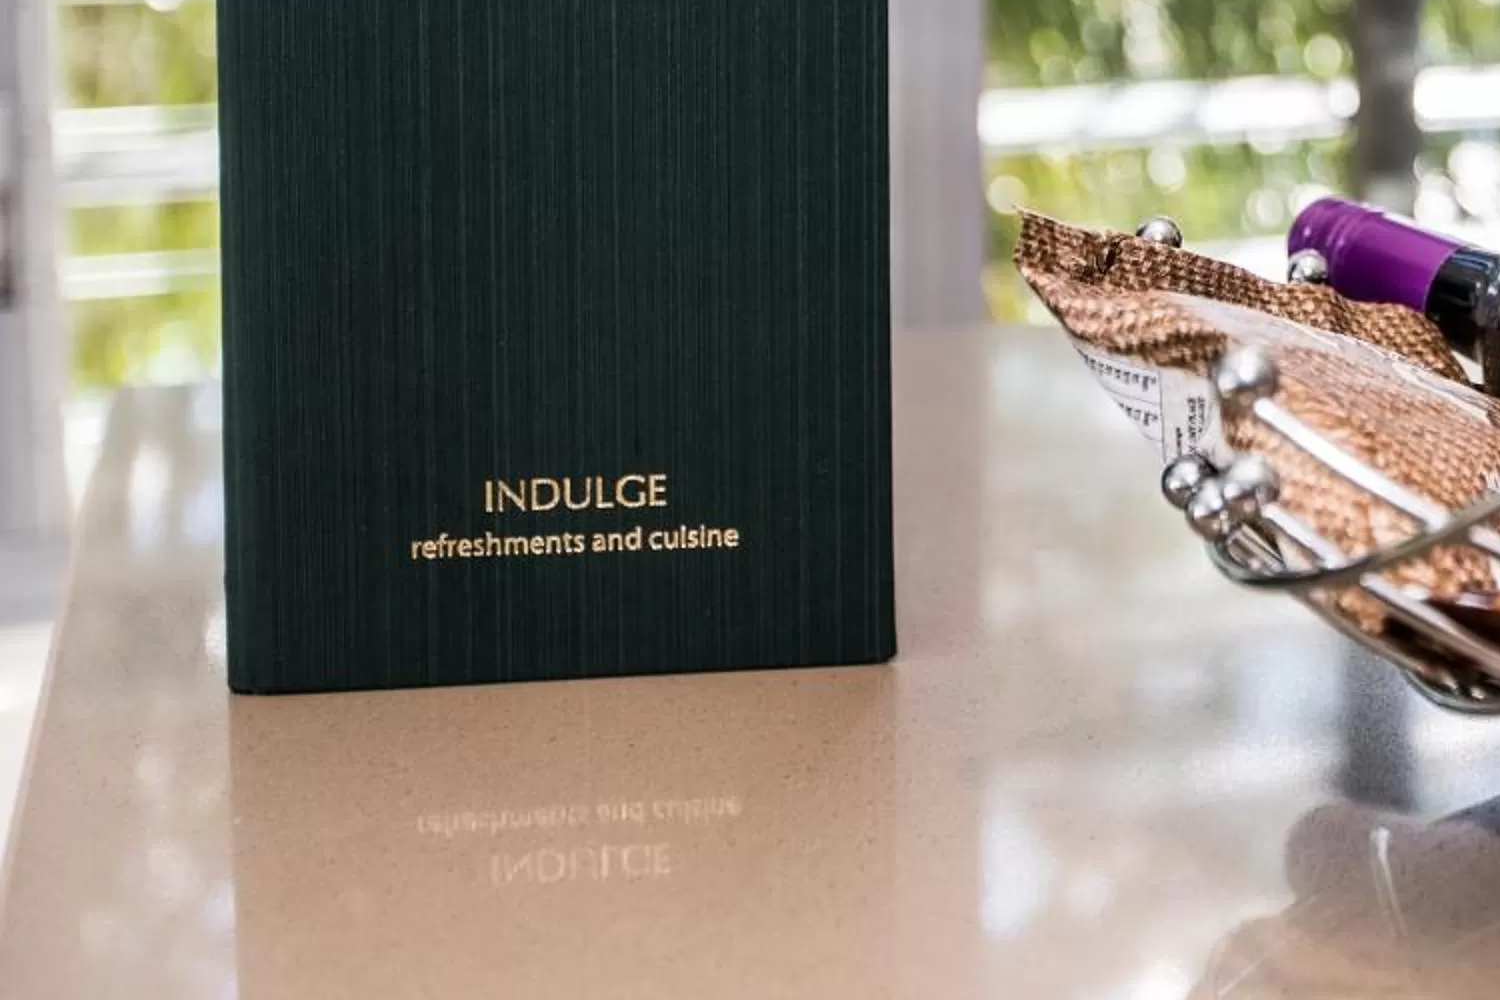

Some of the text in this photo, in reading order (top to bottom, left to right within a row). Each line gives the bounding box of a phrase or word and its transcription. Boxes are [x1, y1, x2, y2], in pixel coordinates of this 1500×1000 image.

[484, 473, 668, 513] INDULGE
[411, 524, 740, 560] refreshments and cuisine
